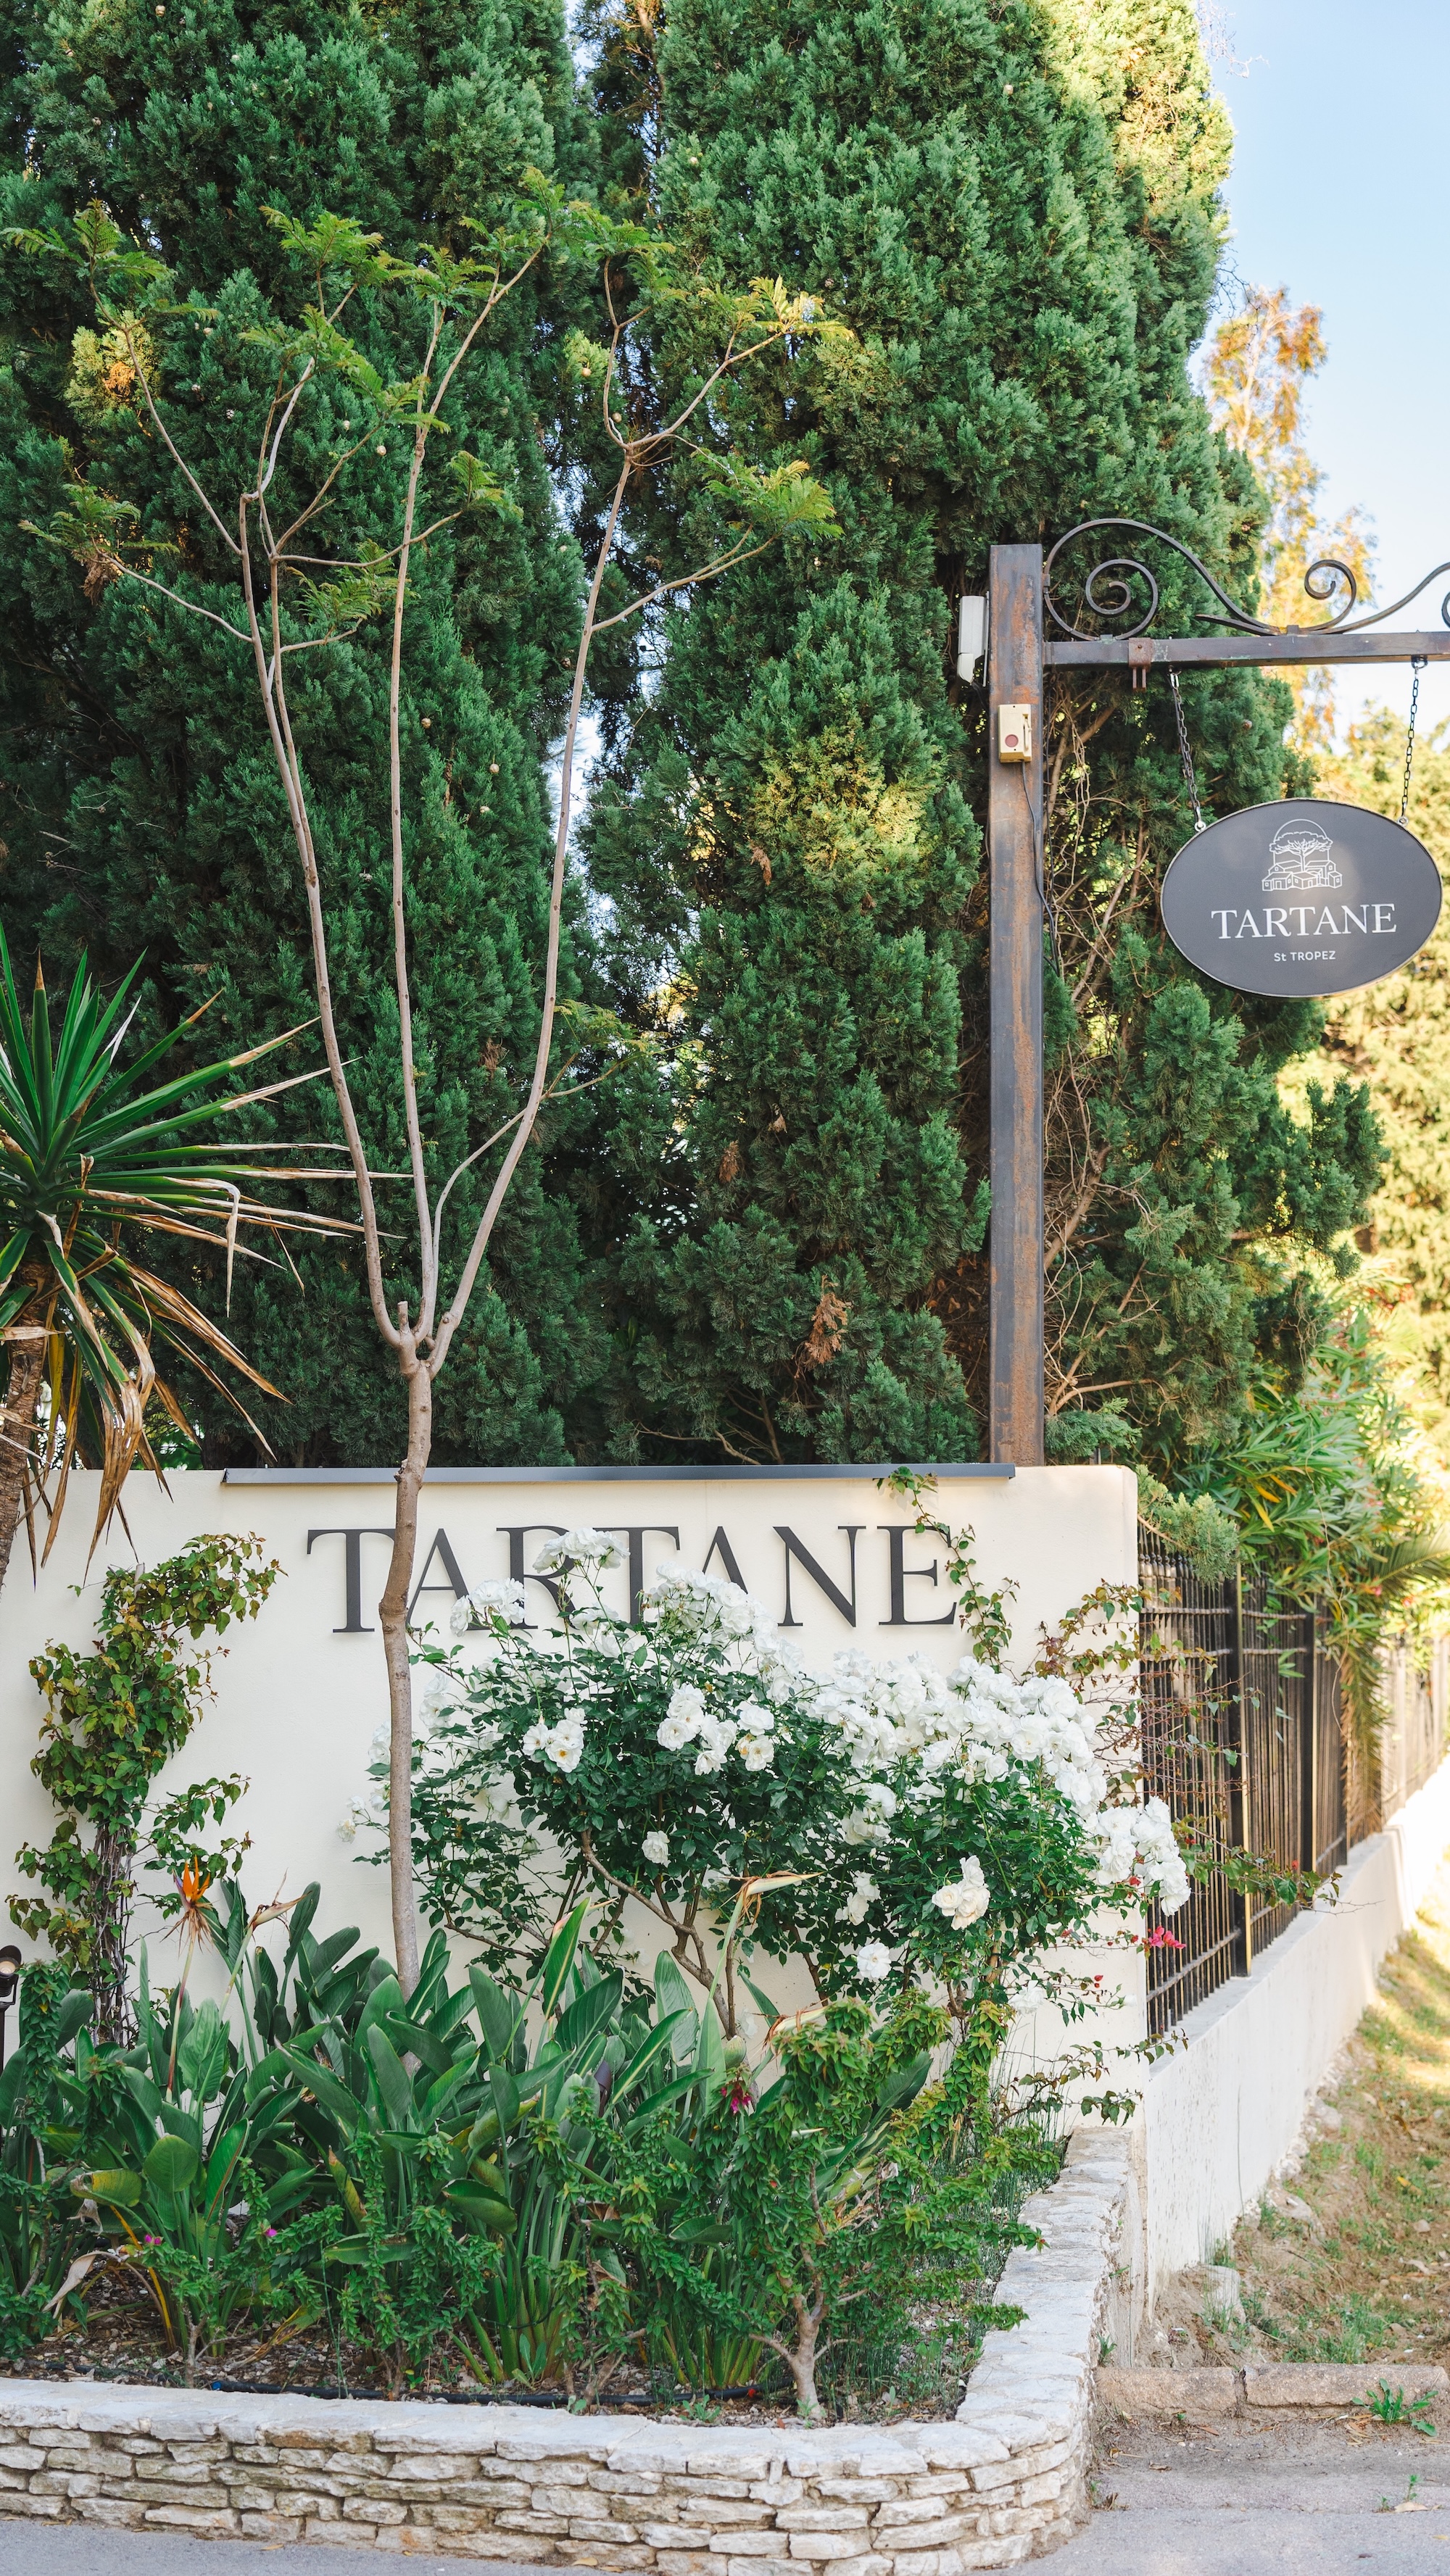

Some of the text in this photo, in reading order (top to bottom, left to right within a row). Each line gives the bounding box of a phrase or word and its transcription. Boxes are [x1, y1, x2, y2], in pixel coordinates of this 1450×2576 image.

[1211, 903, 1397, 939] TARTANE
[1273, 950, 1336, 962] St TROPEZ
